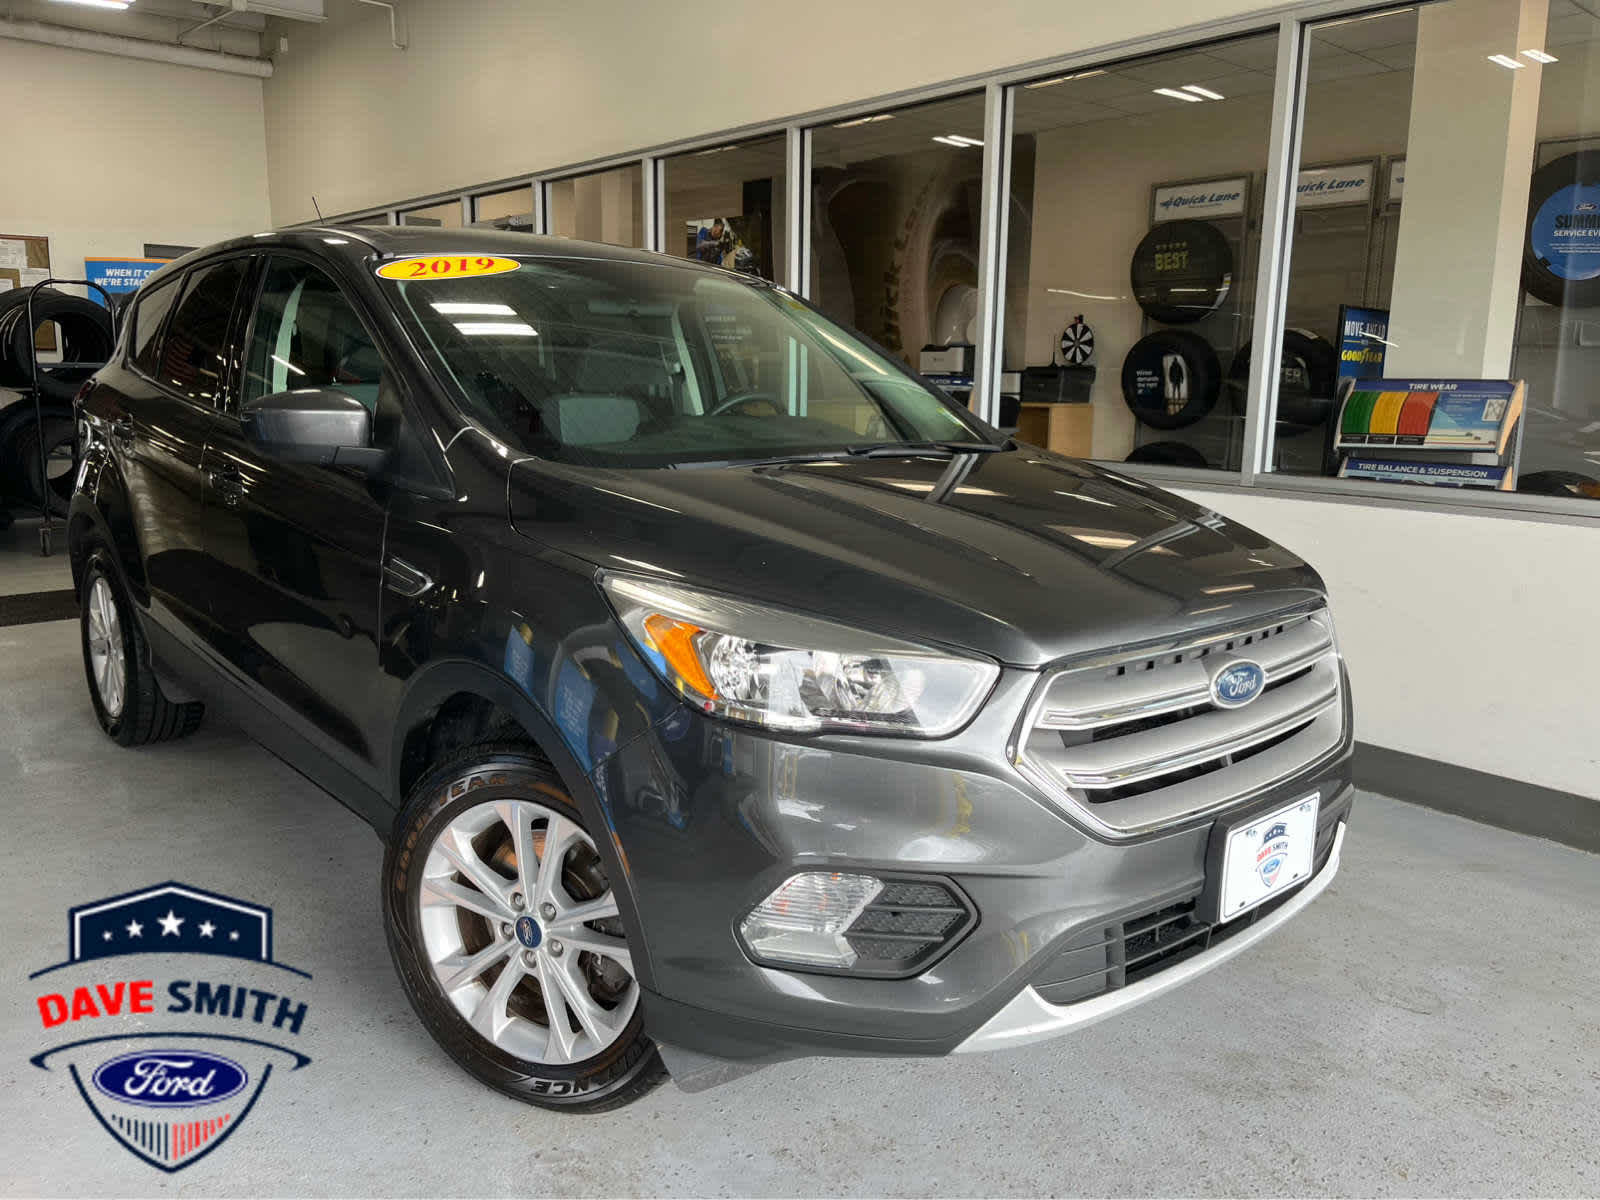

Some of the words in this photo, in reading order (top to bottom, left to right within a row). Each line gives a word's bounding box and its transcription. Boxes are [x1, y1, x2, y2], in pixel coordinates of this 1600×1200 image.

[1296, 181, 1328, 192] uick
[1327, 179, 1365, 189] Lane
[1172, 194, 1207, 208] Quick
[1208, 192, 1240, 202] Lane
[1554, 229, 1588, 237] SERVICE
[408, 258, 495, 277] 2019
[1154, 251, 1189, 270] BEST
[106, 268, 132, 277] WHEN
[134, 269, 142, 277] IT
[94, 277, 122, 286] WE'RE
[1344, 320, 1364, 337] MOVE
[1430, 383, 1458, 391] WEAR
[1358, 463, 1377, 471] TIRE
[1377, 464, 1418, 473] BALANCE
[1427, 467, 1488, 478] SUSPENSION
[1229, 672, 1257, 697] Ford
